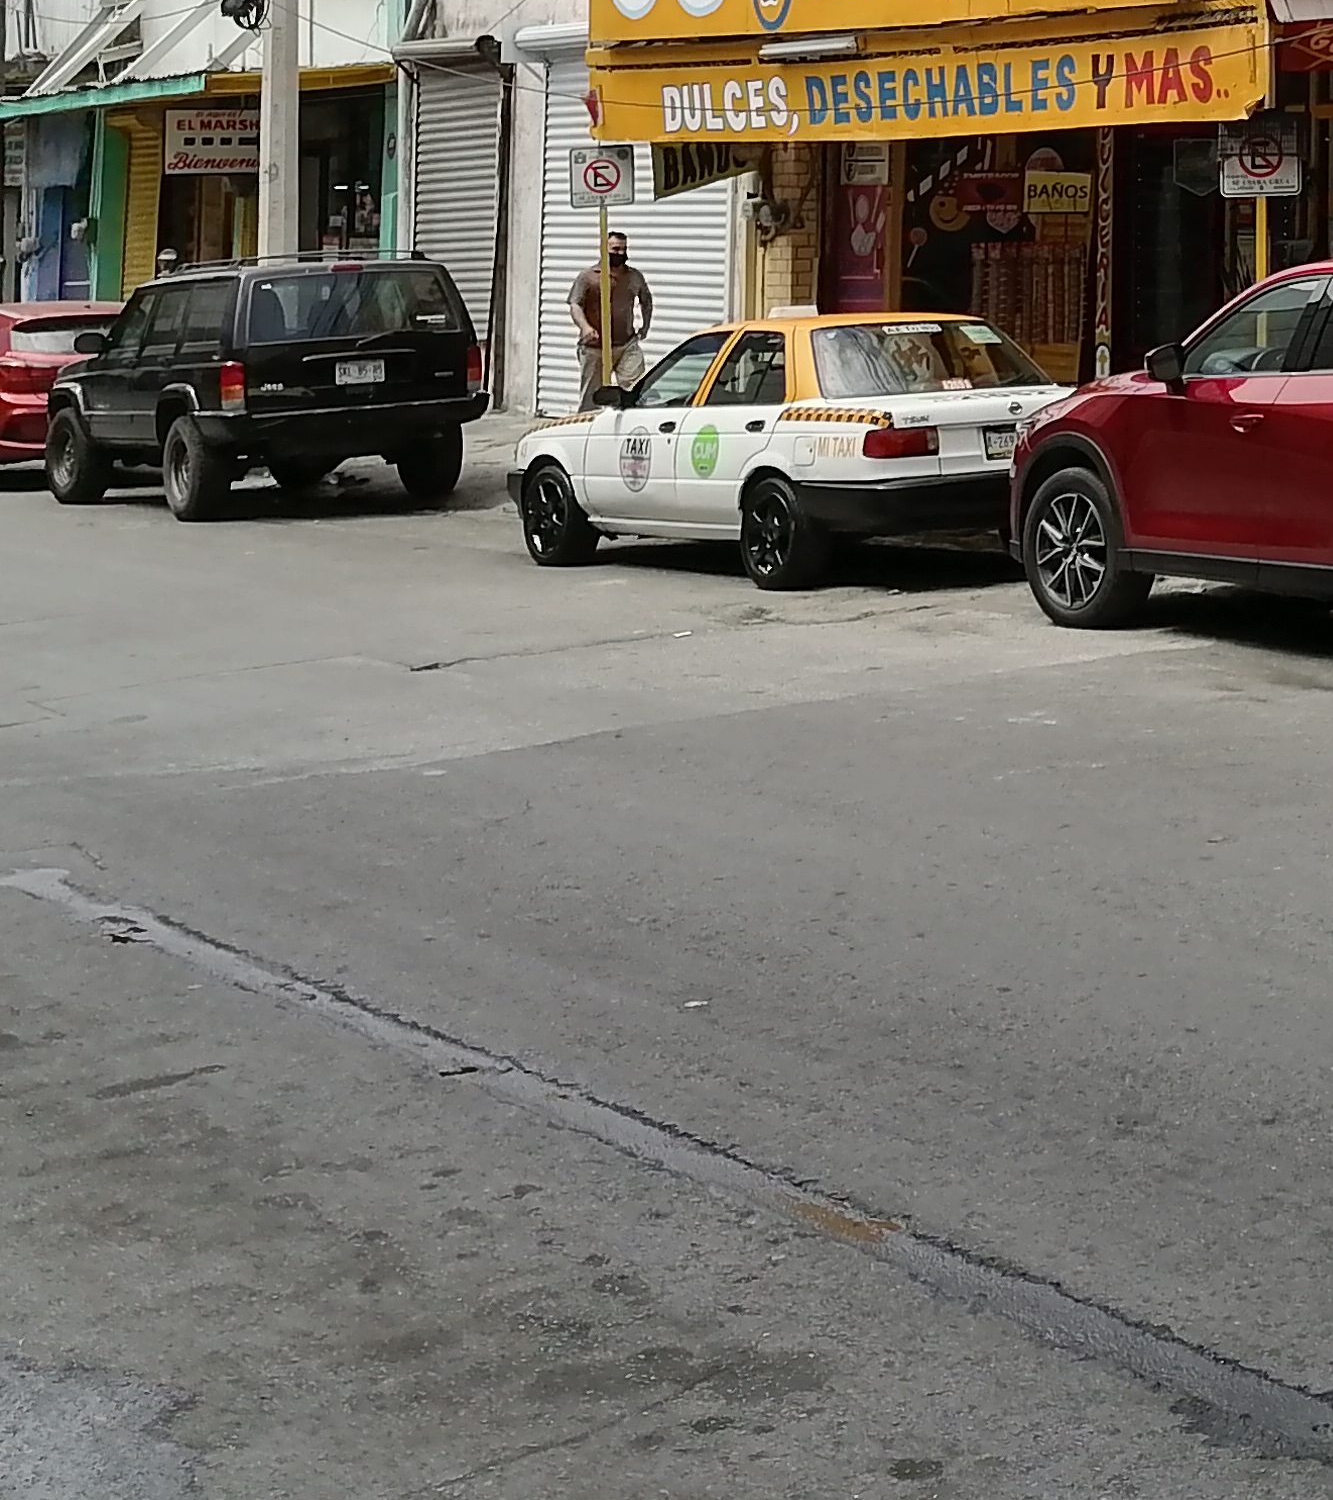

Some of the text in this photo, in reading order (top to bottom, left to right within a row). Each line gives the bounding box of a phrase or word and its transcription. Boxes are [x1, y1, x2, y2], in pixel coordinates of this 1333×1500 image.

[665, 76, 800, 135] DULCES,
[805, 54, 1077, 126] DESECHABLES
[1092, 53, 1114, 110] Y
[177, 119, 259, 131] EL MARSH
[1028, 182, 1088, 199] BAÑOS
[627, 438, 650, 455] TAXI
[818, 437, 857, 458] MI TAXI
